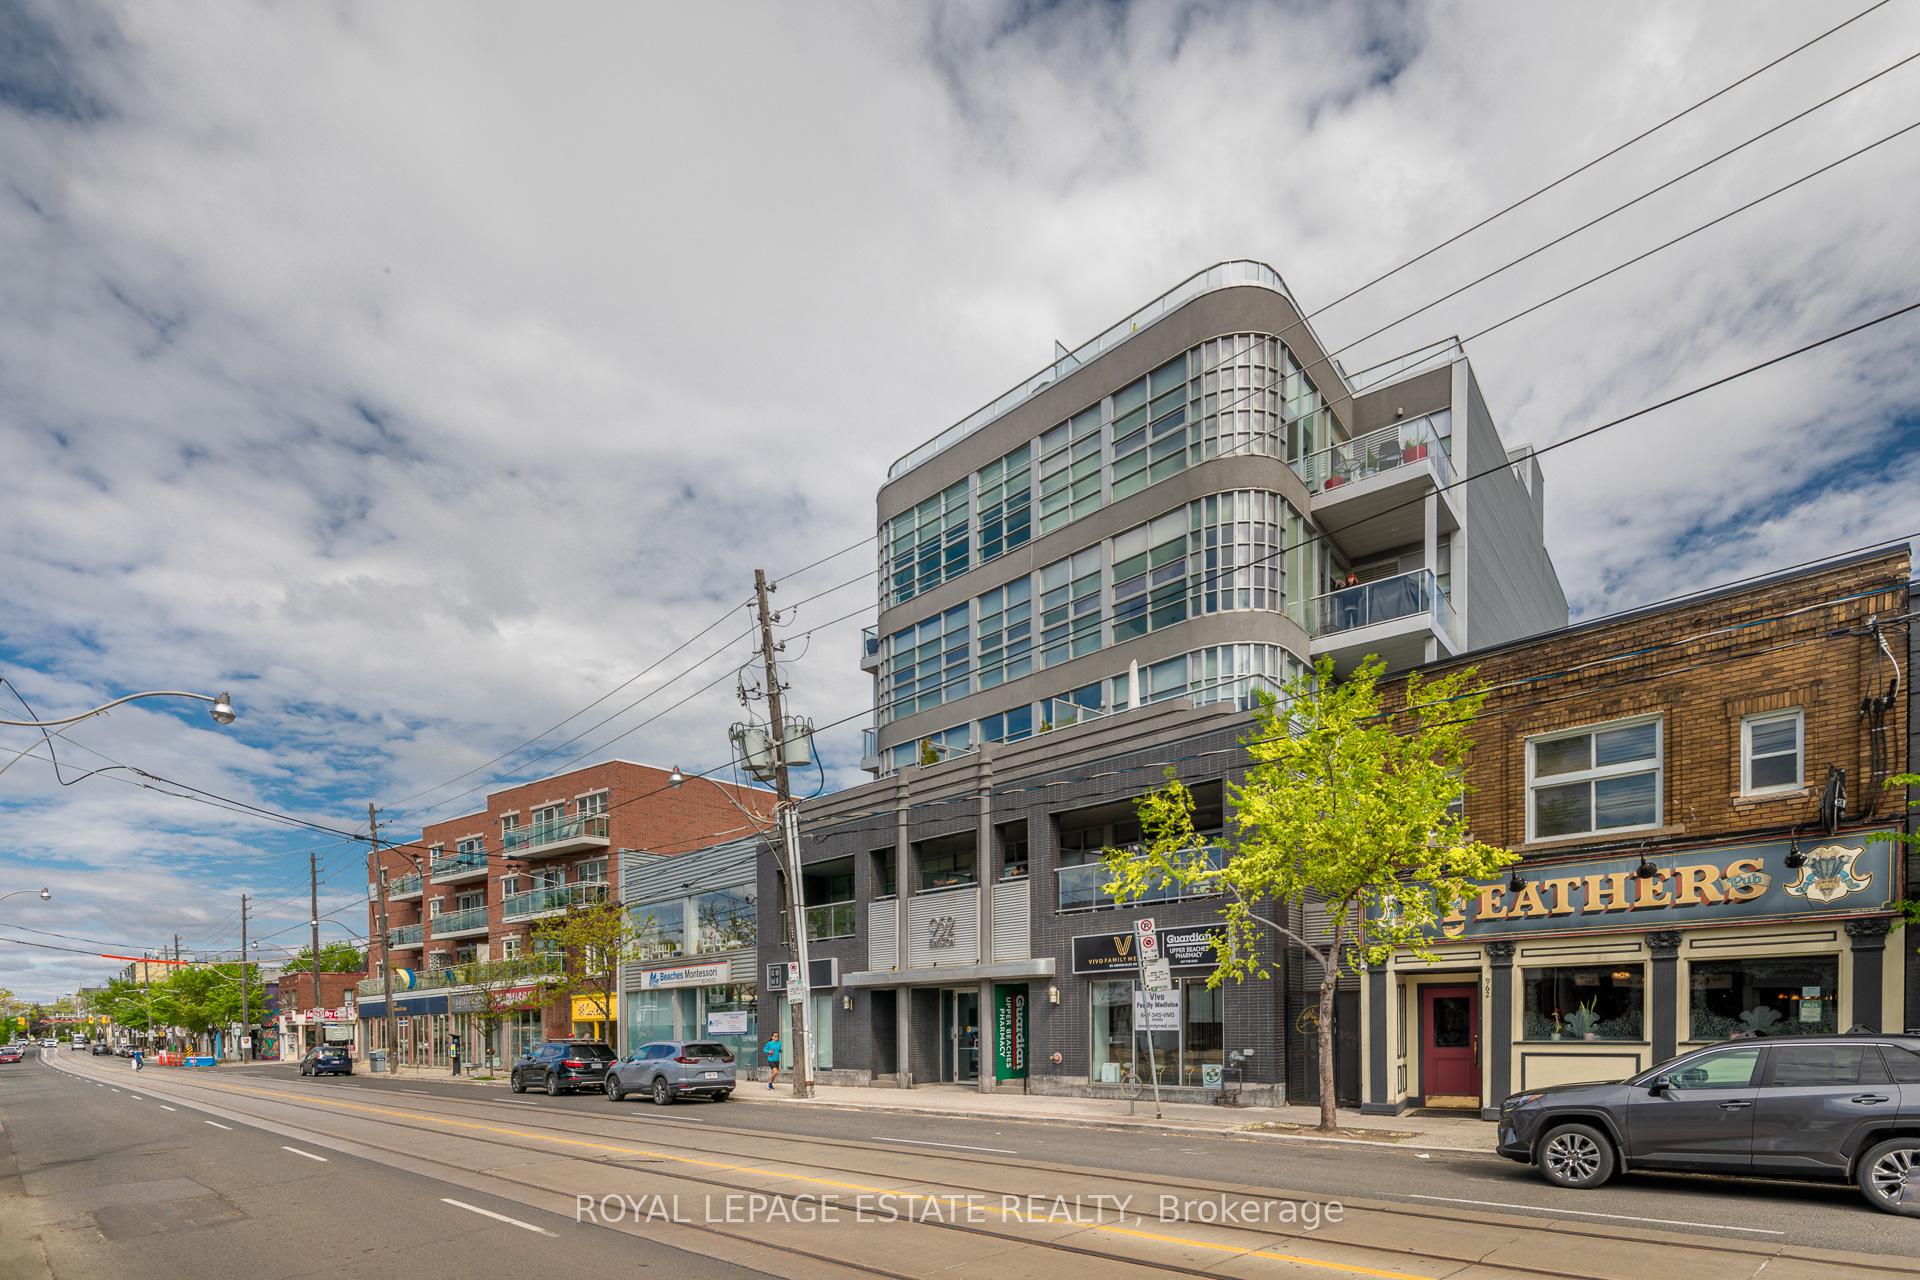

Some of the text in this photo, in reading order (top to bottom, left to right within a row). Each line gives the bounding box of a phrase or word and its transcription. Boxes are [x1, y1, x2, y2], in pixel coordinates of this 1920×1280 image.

[1727, 873, 1762, 889] Pub
[660, 967, 718, 981] Beaches Montessori
[1016, 994, 1025, 1070] Guardian
